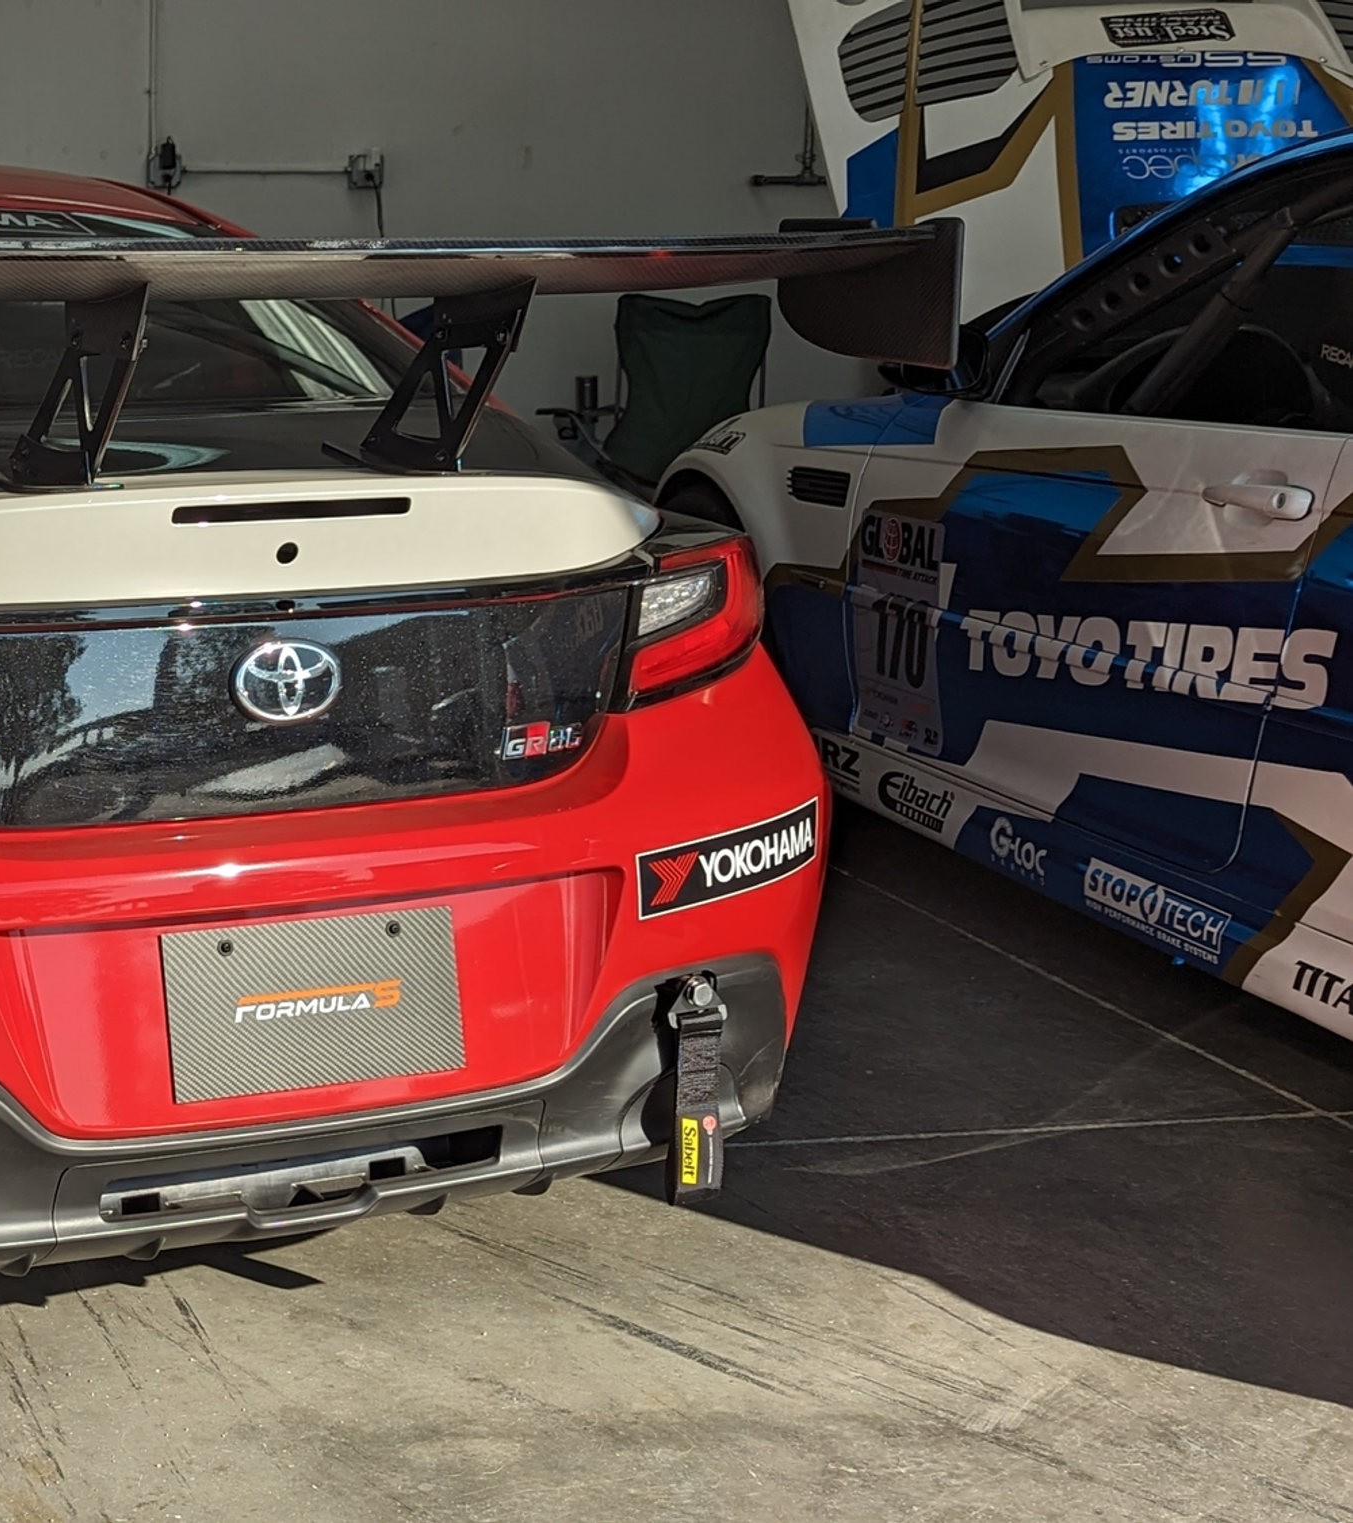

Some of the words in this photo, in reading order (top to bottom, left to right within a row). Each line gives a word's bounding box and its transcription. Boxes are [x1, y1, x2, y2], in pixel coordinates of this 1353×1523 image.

[1108, 15, 1222, 29] MACHINE
[1103, 79, 1232, 108] TURNER
[1112, 120, 1218, 141] TIRES
[1223, 119, 1318, 138] TOYO
[1319, 343, 1353, 369] RECA
[861, 514, 938, 571] GLOBAL
[913, 572, 938, 585] ATTACK
[872, 594, 931, 688] 170
[960, 609, 1121, 686] TOYO
[1124, 621, 1338, 710] TIRES
[814, 734, 859, 777] RZ
[878, 771, 952, 818] Eibach
[698, 817, 813, 888] YOKOHAMA
[1085, 899, 1102, 912] HIGH
[1104, 907, 1156, 937] PERFORMANCE
[1156, 931, 1182, 949] BRAKE
[1183, 943, 1219, 965] SYSTEMS
[683, 1125, 697, 1177] Sabelt
